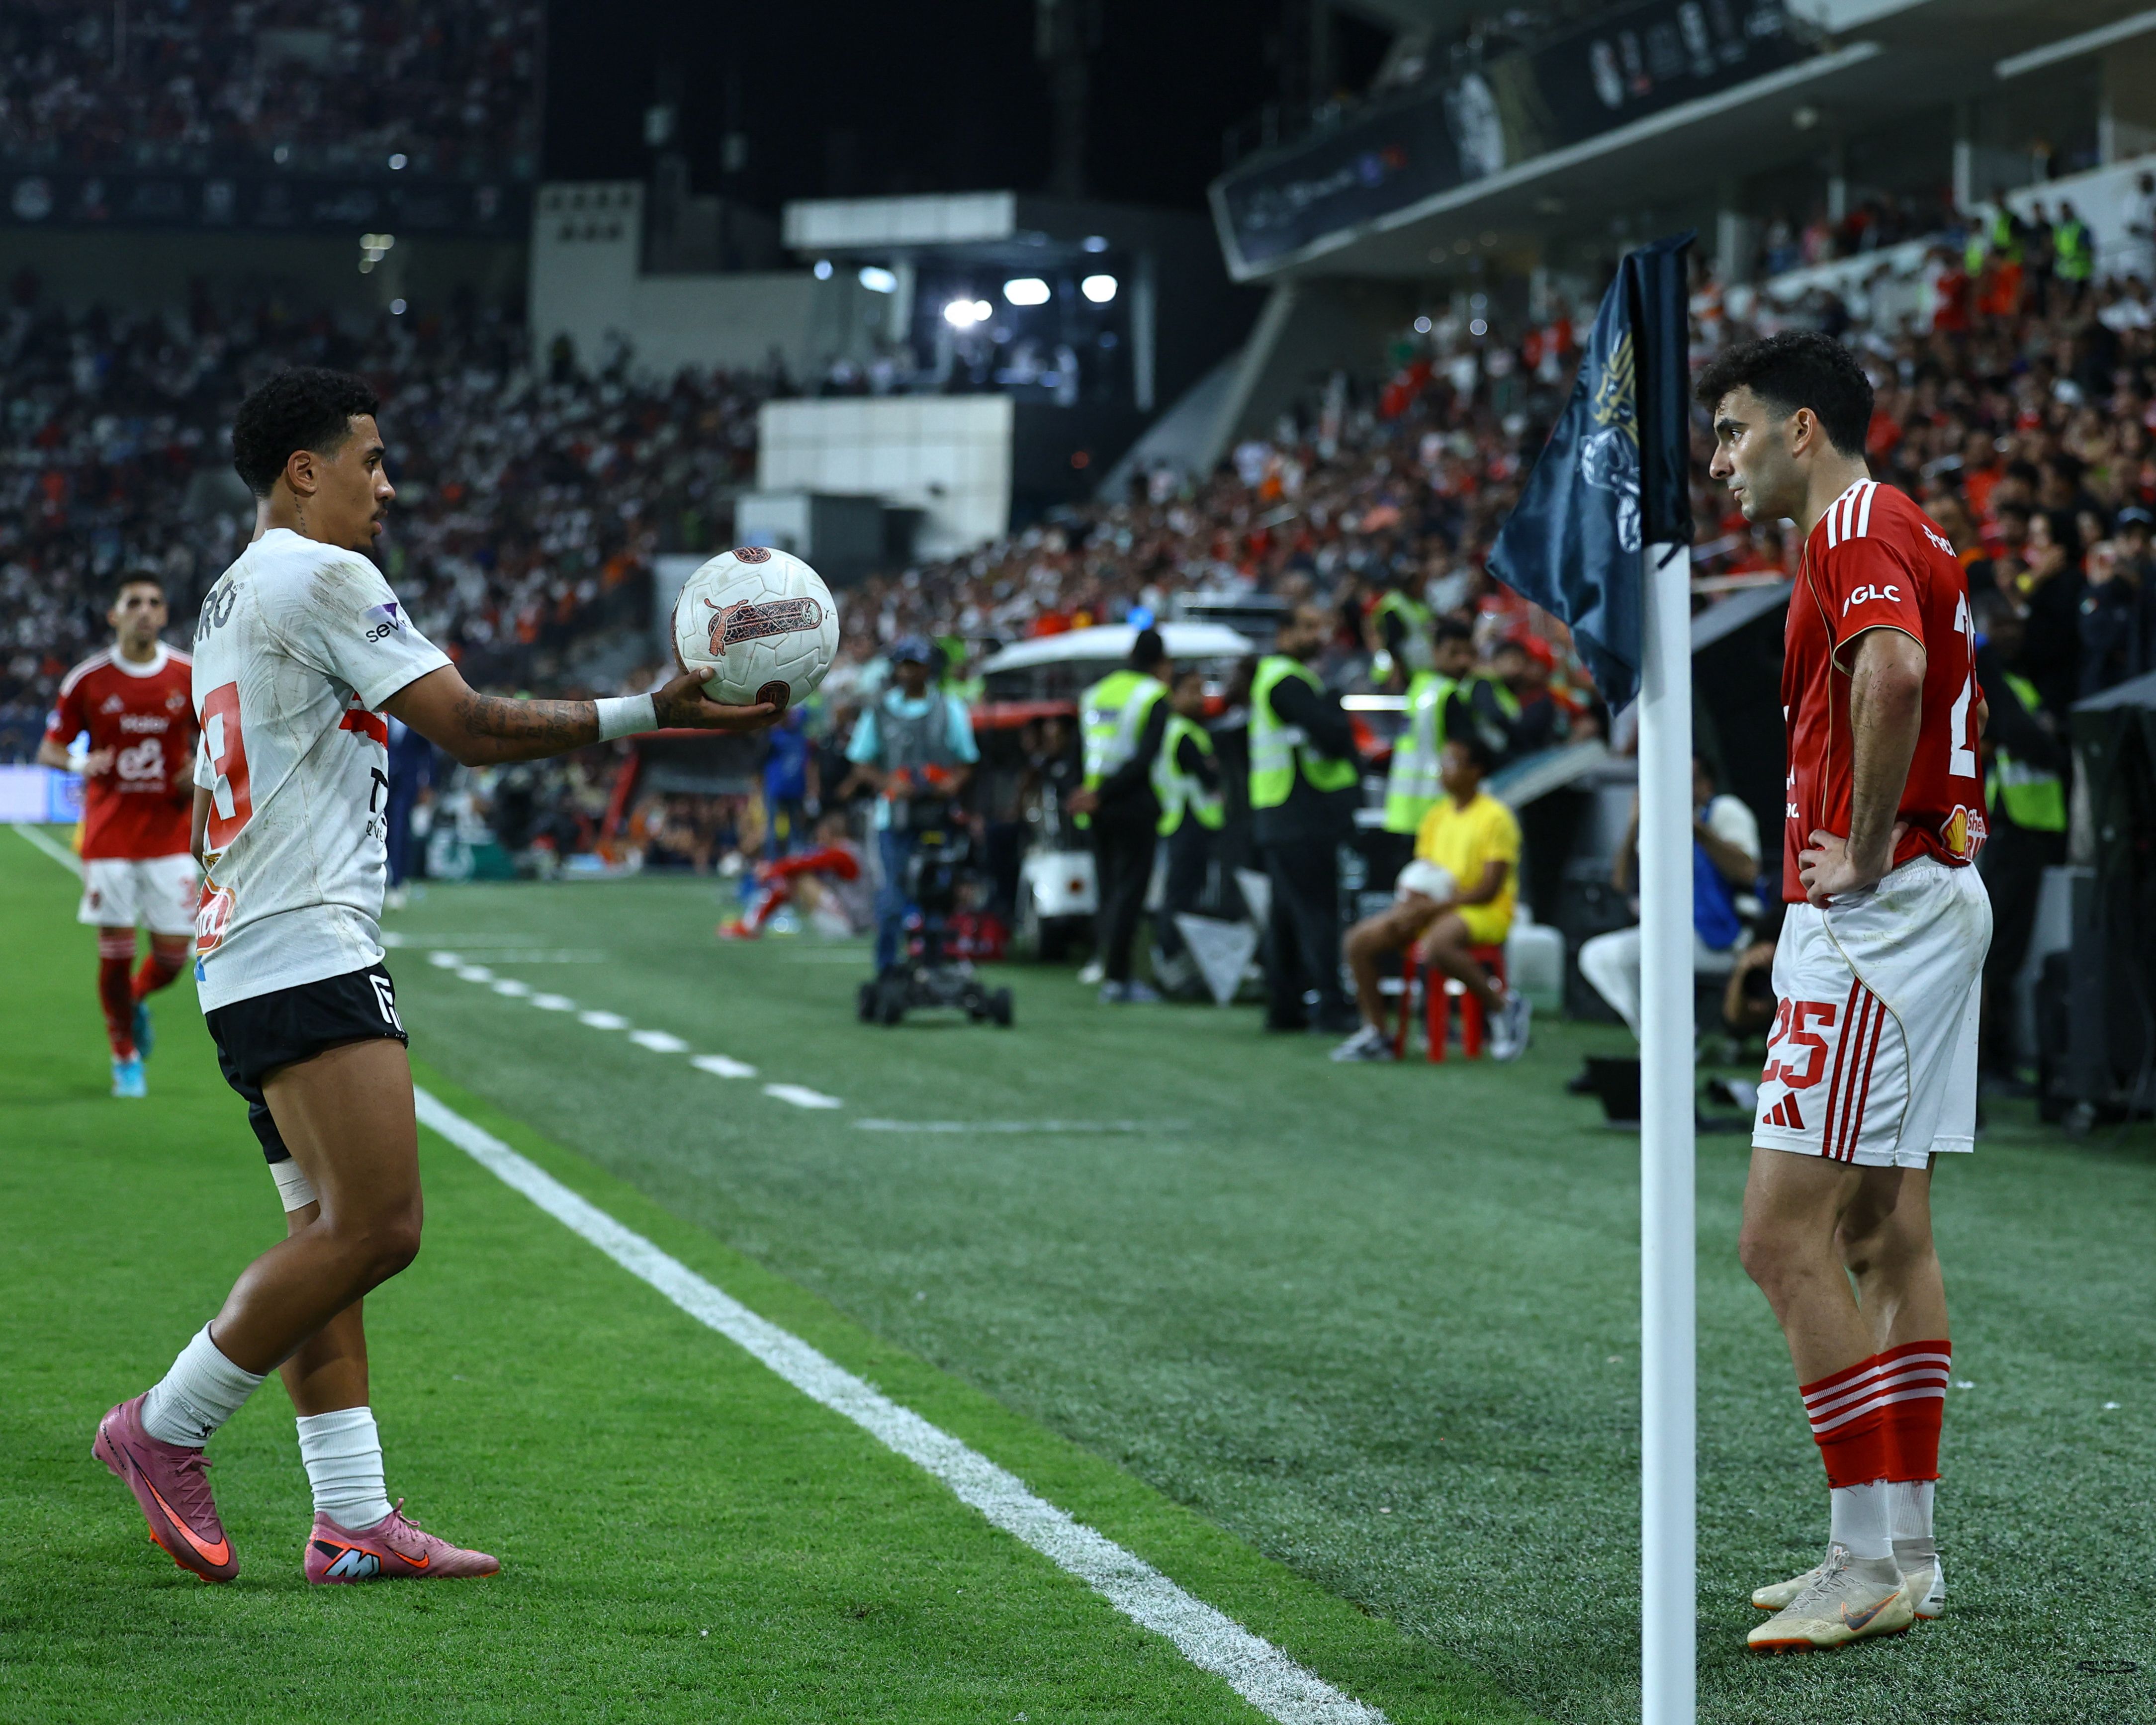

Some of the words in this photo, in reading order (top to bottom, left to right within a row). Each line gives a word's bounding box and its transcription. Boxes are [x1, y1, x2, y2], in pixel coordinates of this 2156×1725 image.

[193, 580, 237, 645] RO
[1851, 584, 1901, 605] GLC
[1761, 997, 1837, 1089] 25
